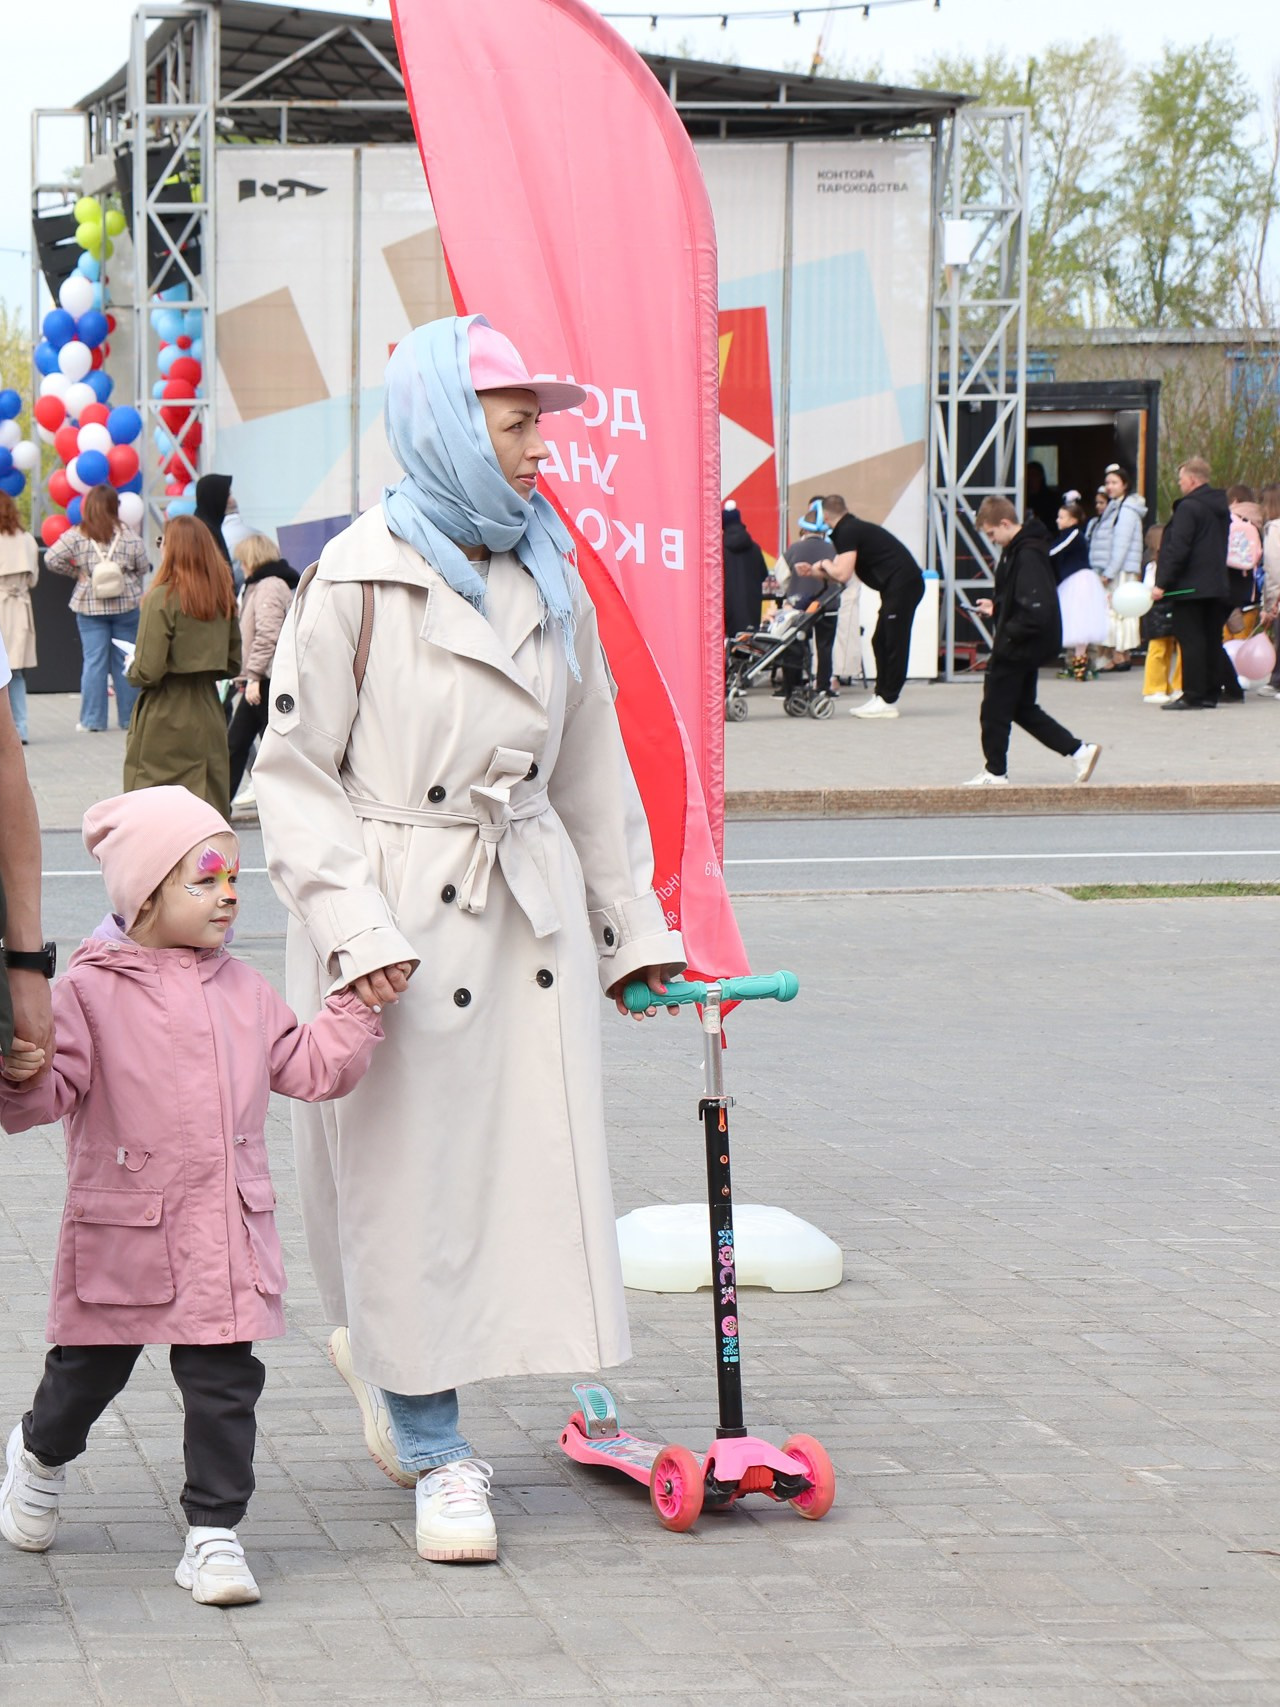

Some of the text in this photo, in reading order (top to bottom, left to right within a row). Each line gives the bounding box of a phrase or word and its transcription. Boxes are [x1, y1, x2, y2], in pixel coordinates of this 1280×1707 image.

[817, 169, 875, 180] КОНТОРА
[817, 182, 909, 194] ПАРОХОДСТВА
[718, 1229, 736, 1305] ROCK
